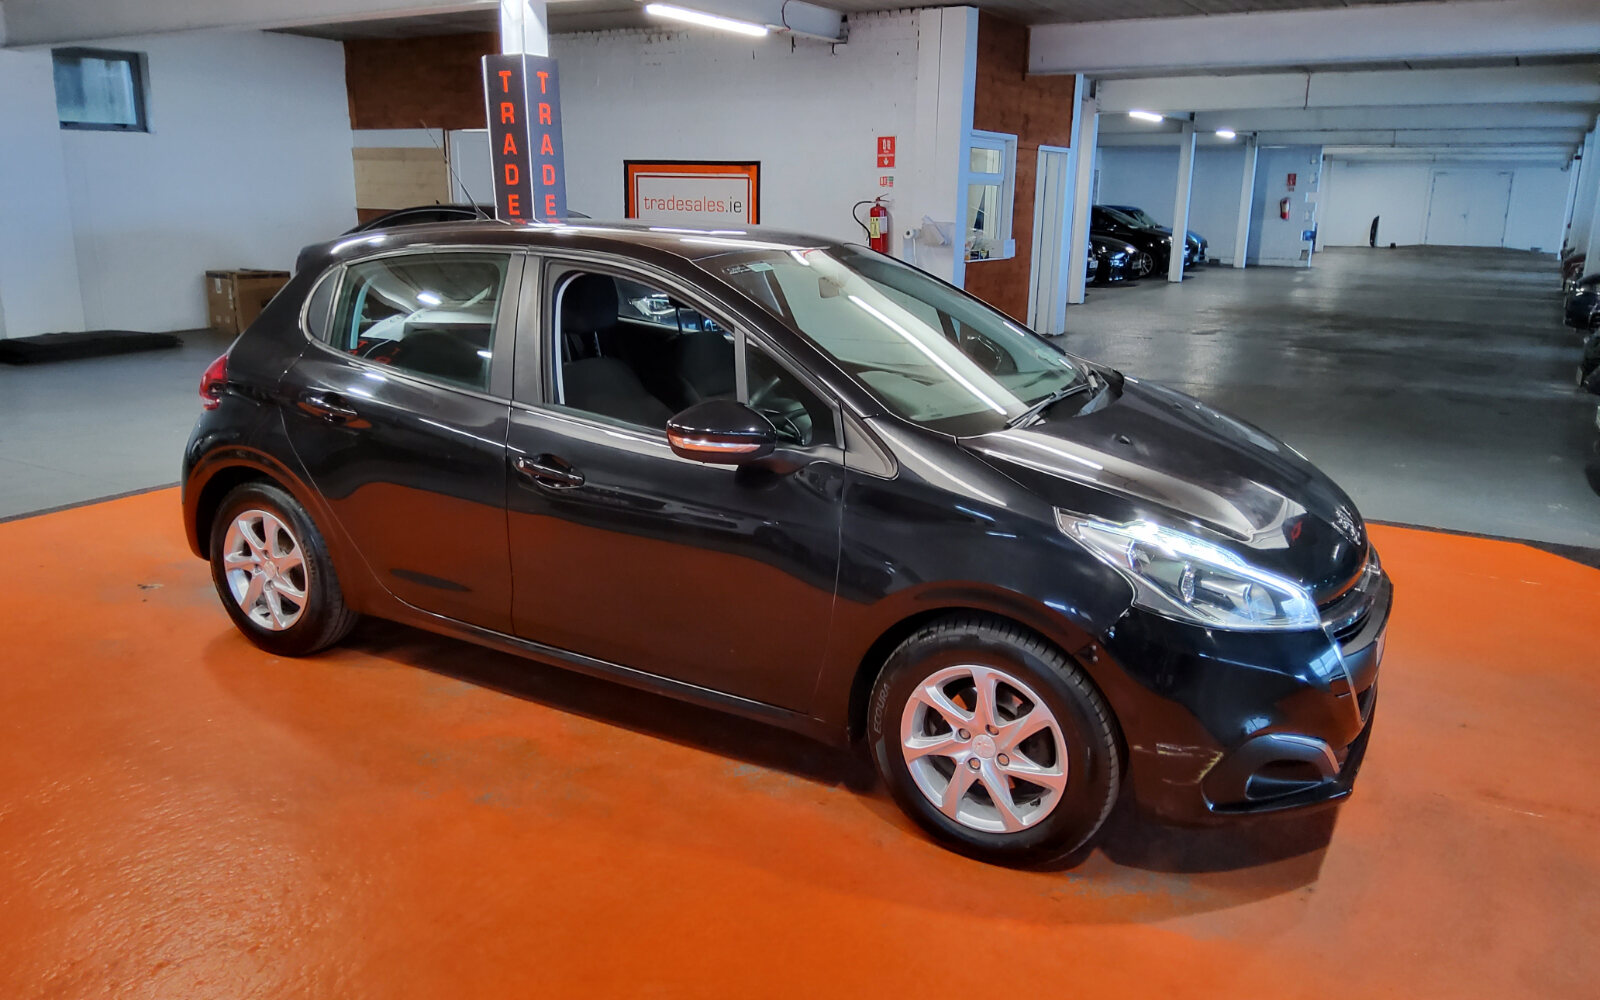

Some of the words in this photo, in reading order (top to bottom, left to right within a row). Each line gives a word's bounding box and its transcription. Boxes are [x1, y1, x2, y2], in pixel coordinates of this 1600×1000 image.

[498, 70, 520, 216] TRADE
[536, 71, 557, 216] TRADE
[643, 195, 742, 213] tradesales.ie
